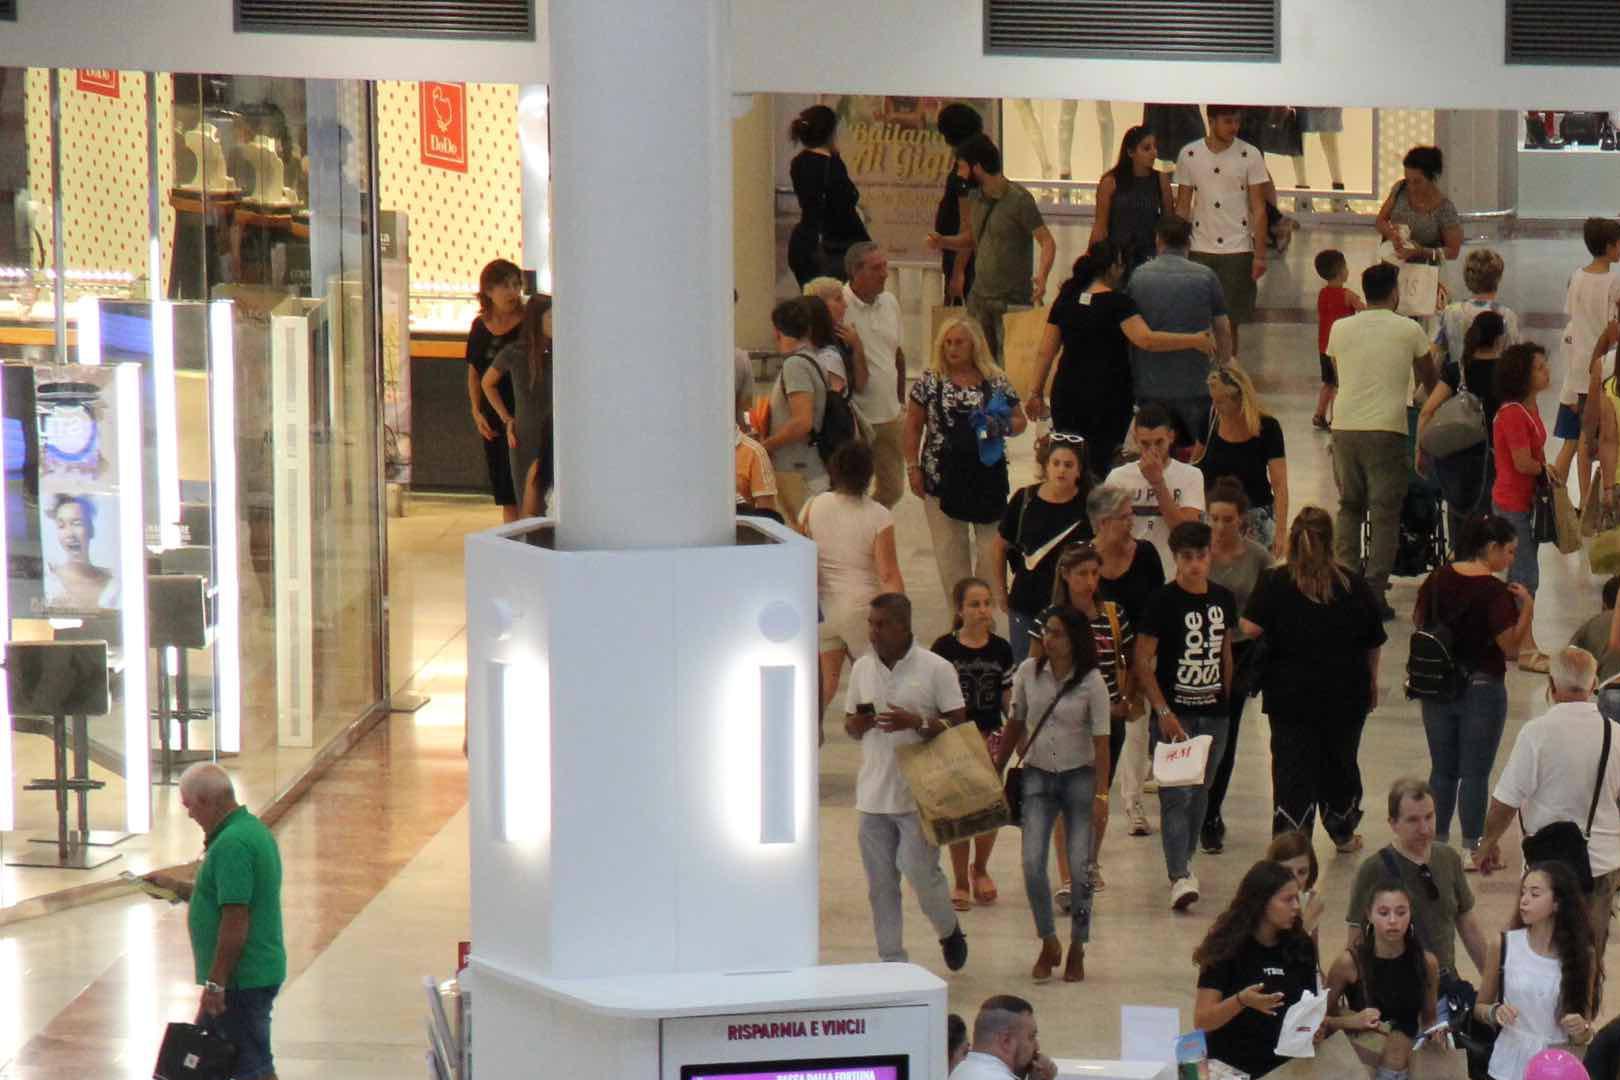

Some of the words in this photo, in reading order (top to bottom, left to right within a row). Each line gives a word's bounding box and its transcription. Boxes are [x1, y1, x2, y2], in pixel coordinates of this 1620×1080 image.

[430, 133, 458, 154] DoDo
[1176, 611, 1204, 685] Shoe
[1202, 604, 1225, 684] Shine
[727, 1022, 807, 1041] RISPARMIA
[810, 1020, 819, 1036] E
[821, 1018, 866, 1036] VINCI!
